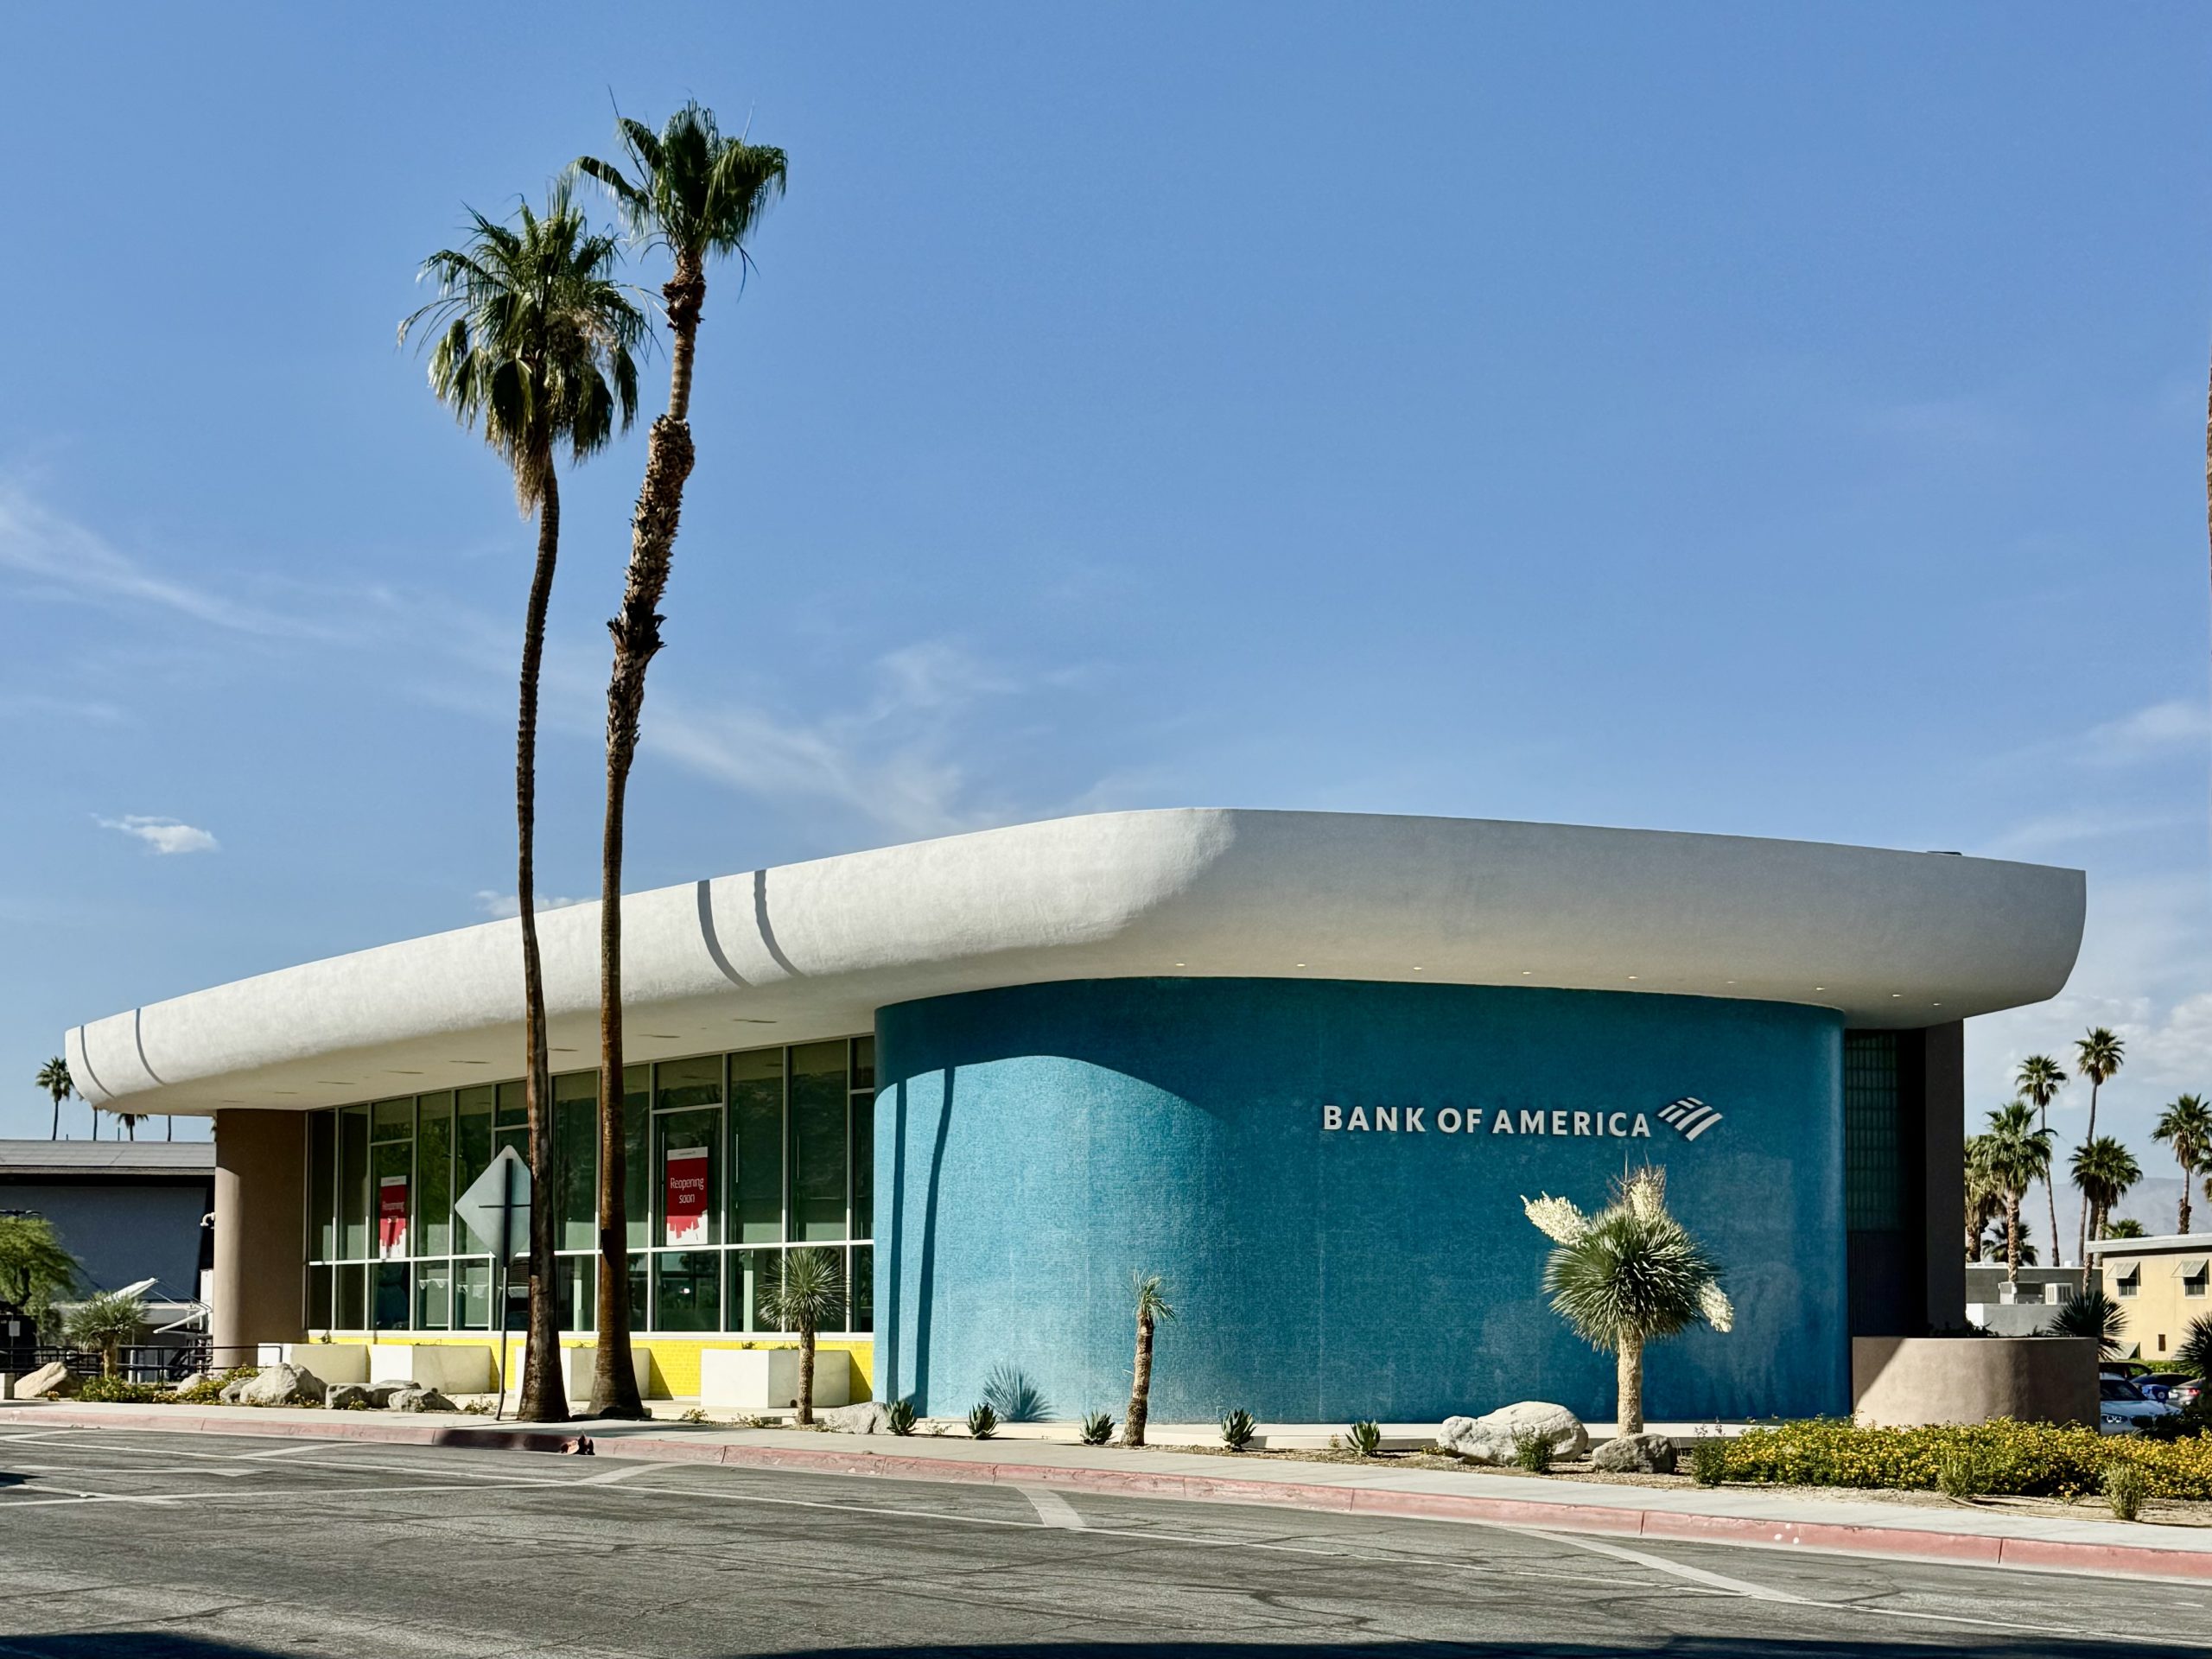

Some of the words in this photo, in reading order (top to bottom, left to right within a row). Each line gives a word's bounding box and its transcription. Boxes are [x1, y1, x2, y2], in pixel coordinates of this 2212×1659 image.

[1323, 1105, 1426, 1133] BANK
[1437, 1108, 1483, 1134] OF
[1492, 1109, 1651, 1137] AMERICA
[670, 1177, 704, 1191] Reopening
[679, 1194, 696, 1204] soon
